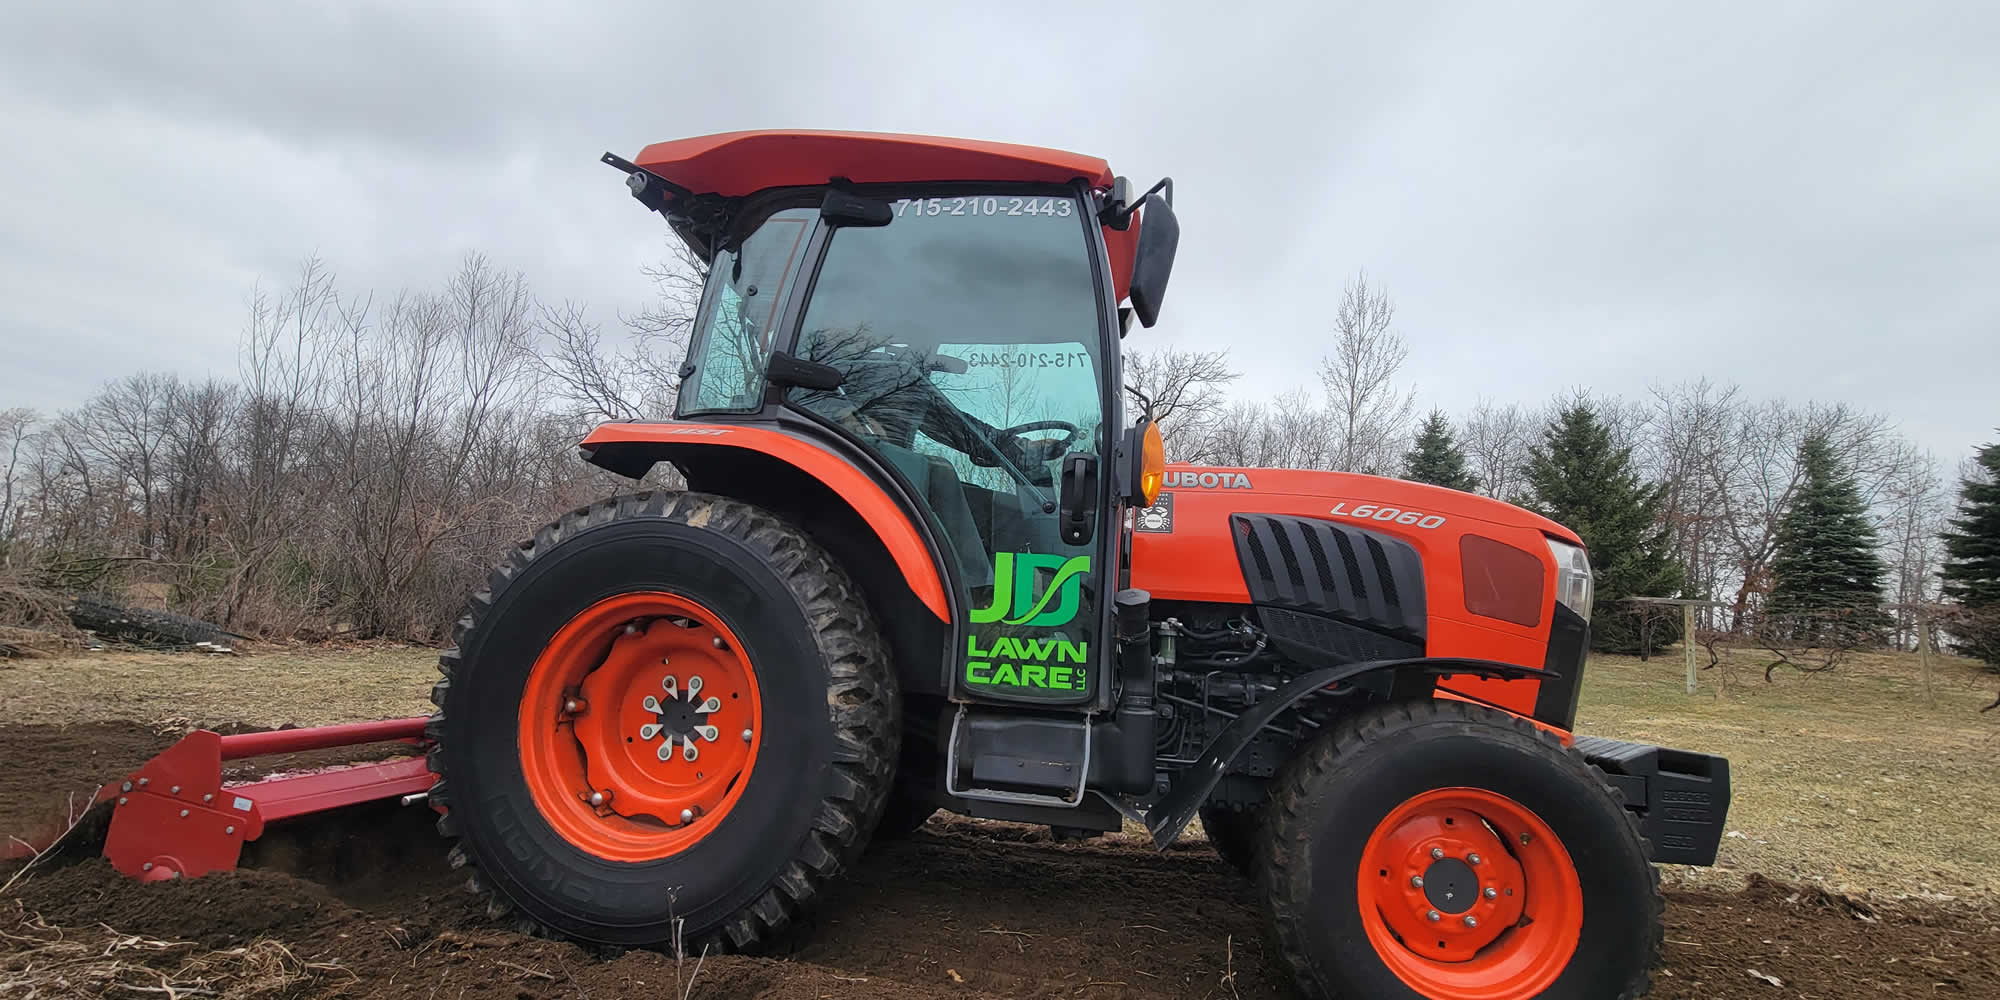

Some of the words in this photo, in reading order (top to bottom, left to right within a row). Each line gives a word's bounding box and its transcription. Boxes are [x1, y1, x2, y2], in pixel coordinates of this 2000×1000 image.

[896, 197, 1072, 217] 715-210-2443
[1162, 471, 1253, 489] UBOTA
[1330, 502, 1447, 529] L6060
[967, 635, 1088, 664] LAWN
[966, 661, 1073, 690] CARE
[1076, 668, 1086, 691] LLC
